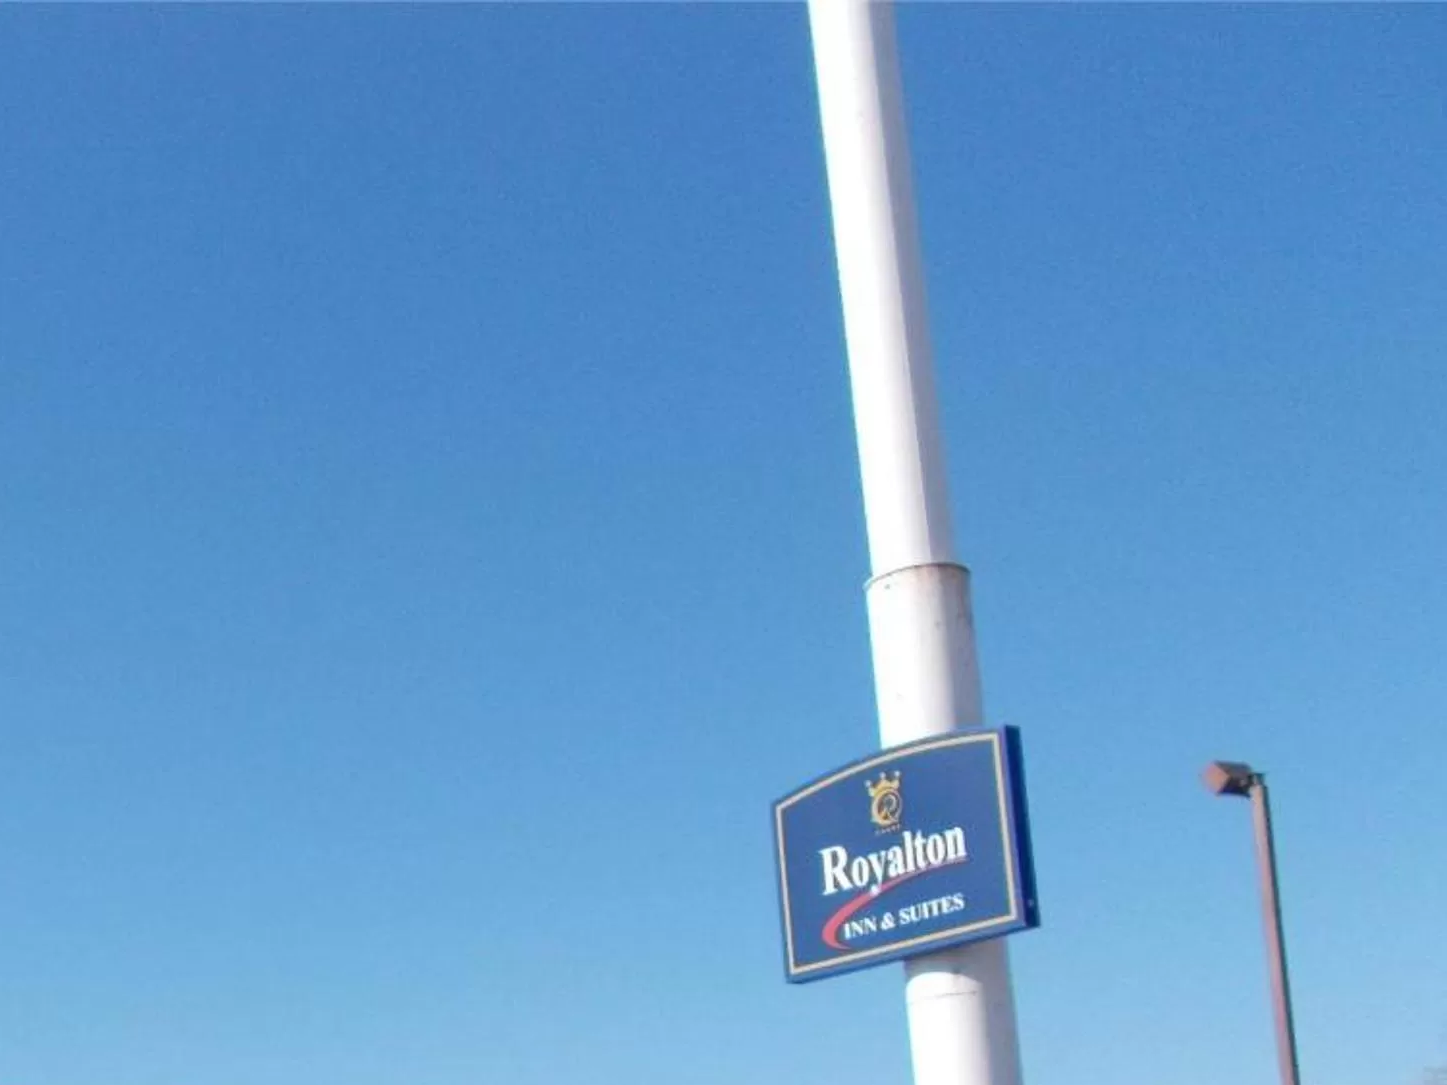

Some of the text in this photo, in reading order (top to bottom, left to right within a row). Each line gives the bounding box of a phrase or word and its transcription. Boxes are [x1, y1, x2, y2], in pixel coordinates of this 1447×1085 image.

[818, 825, 967, 896] Royalton
[843, 892, 966, 941] INN & SUITES
